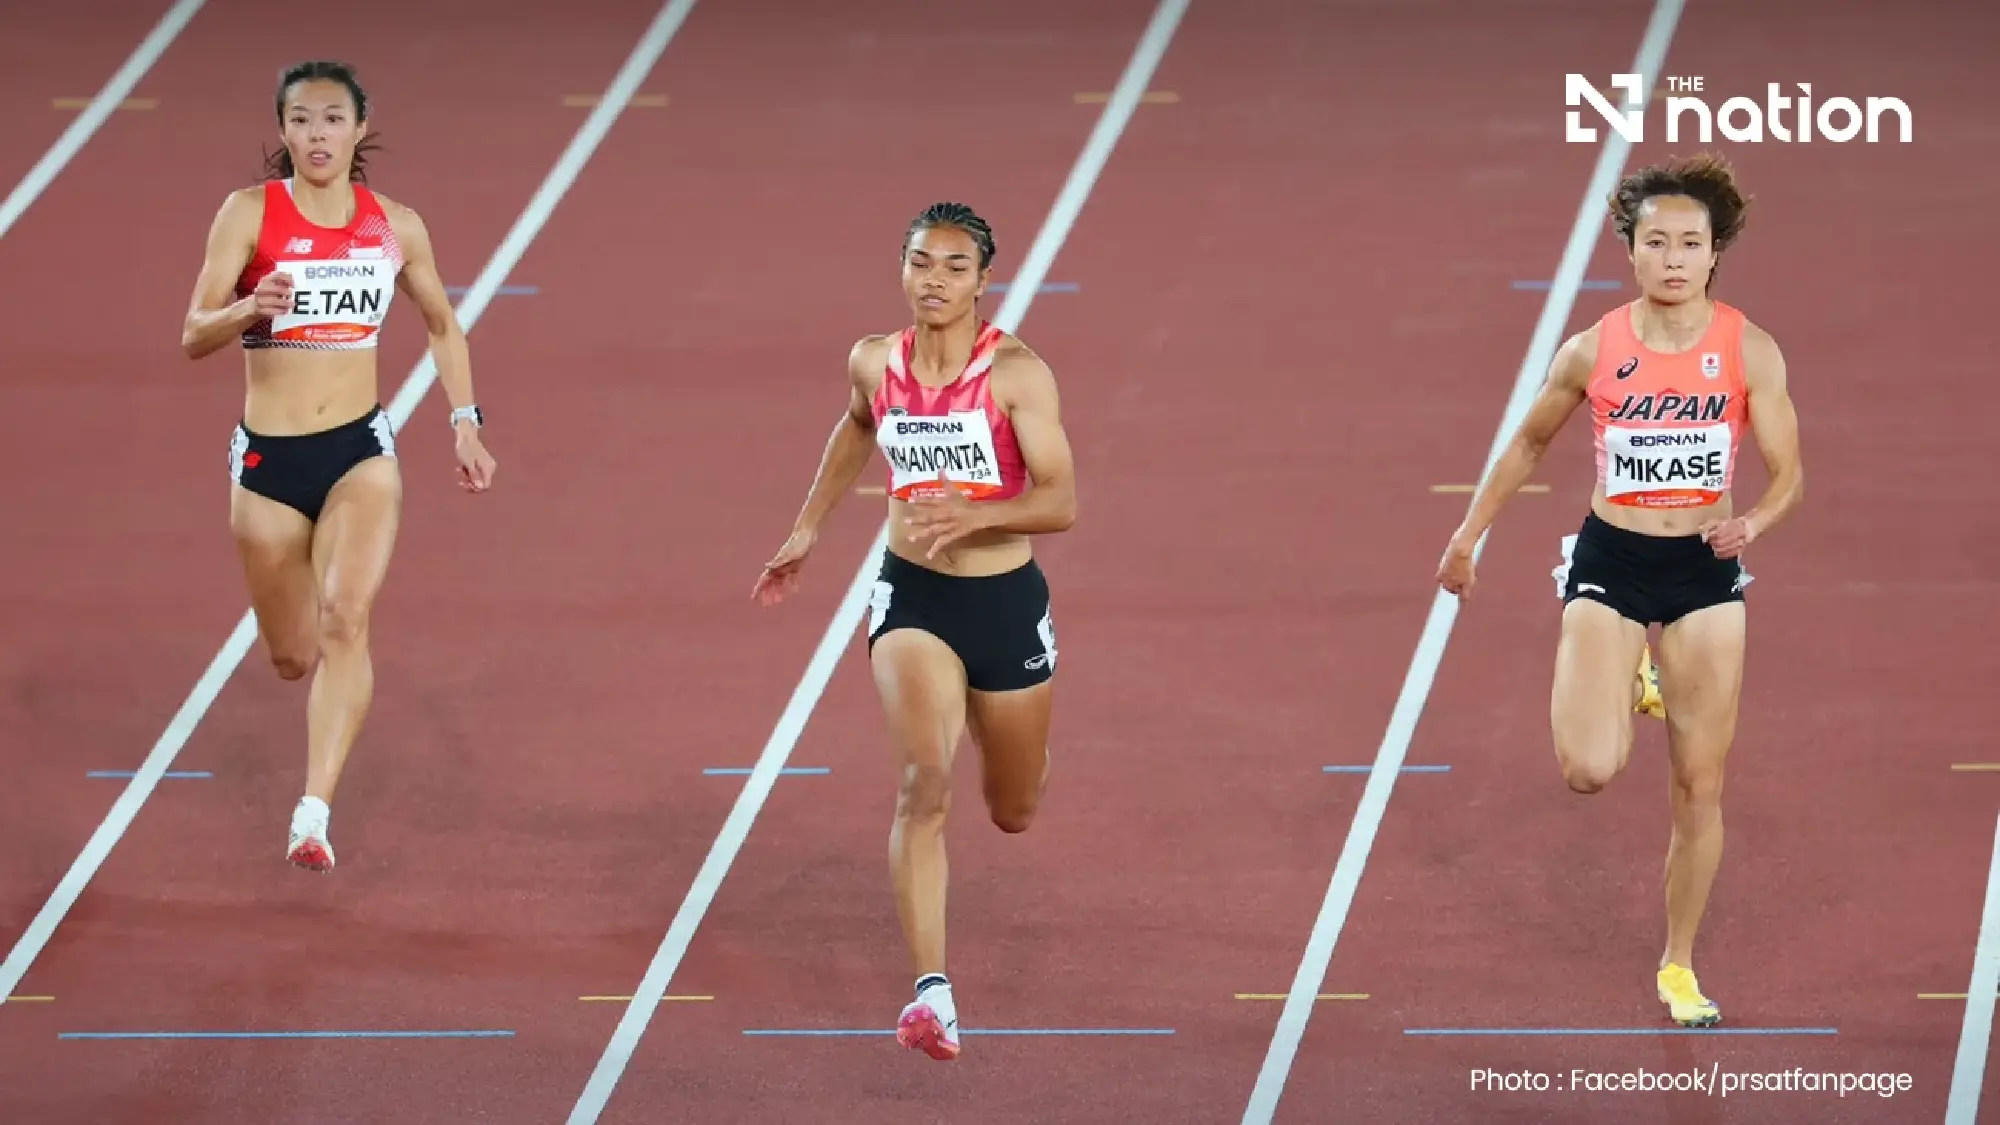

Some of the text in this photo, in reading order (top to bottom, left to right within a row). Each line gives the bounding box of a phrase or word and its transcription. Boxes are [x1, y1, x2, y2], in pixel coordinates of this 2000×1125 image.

[305, 265, 375, 279] BORNAN
[292, 288, 382, 315] E.TAN
[1608, 394, 1728, 421] JAPAN
[896, 421, 963, 434] BORNAN
[1629, 432, 1706, 447] BORNAN
[1614, 450, 1723, 483] MIKASE
